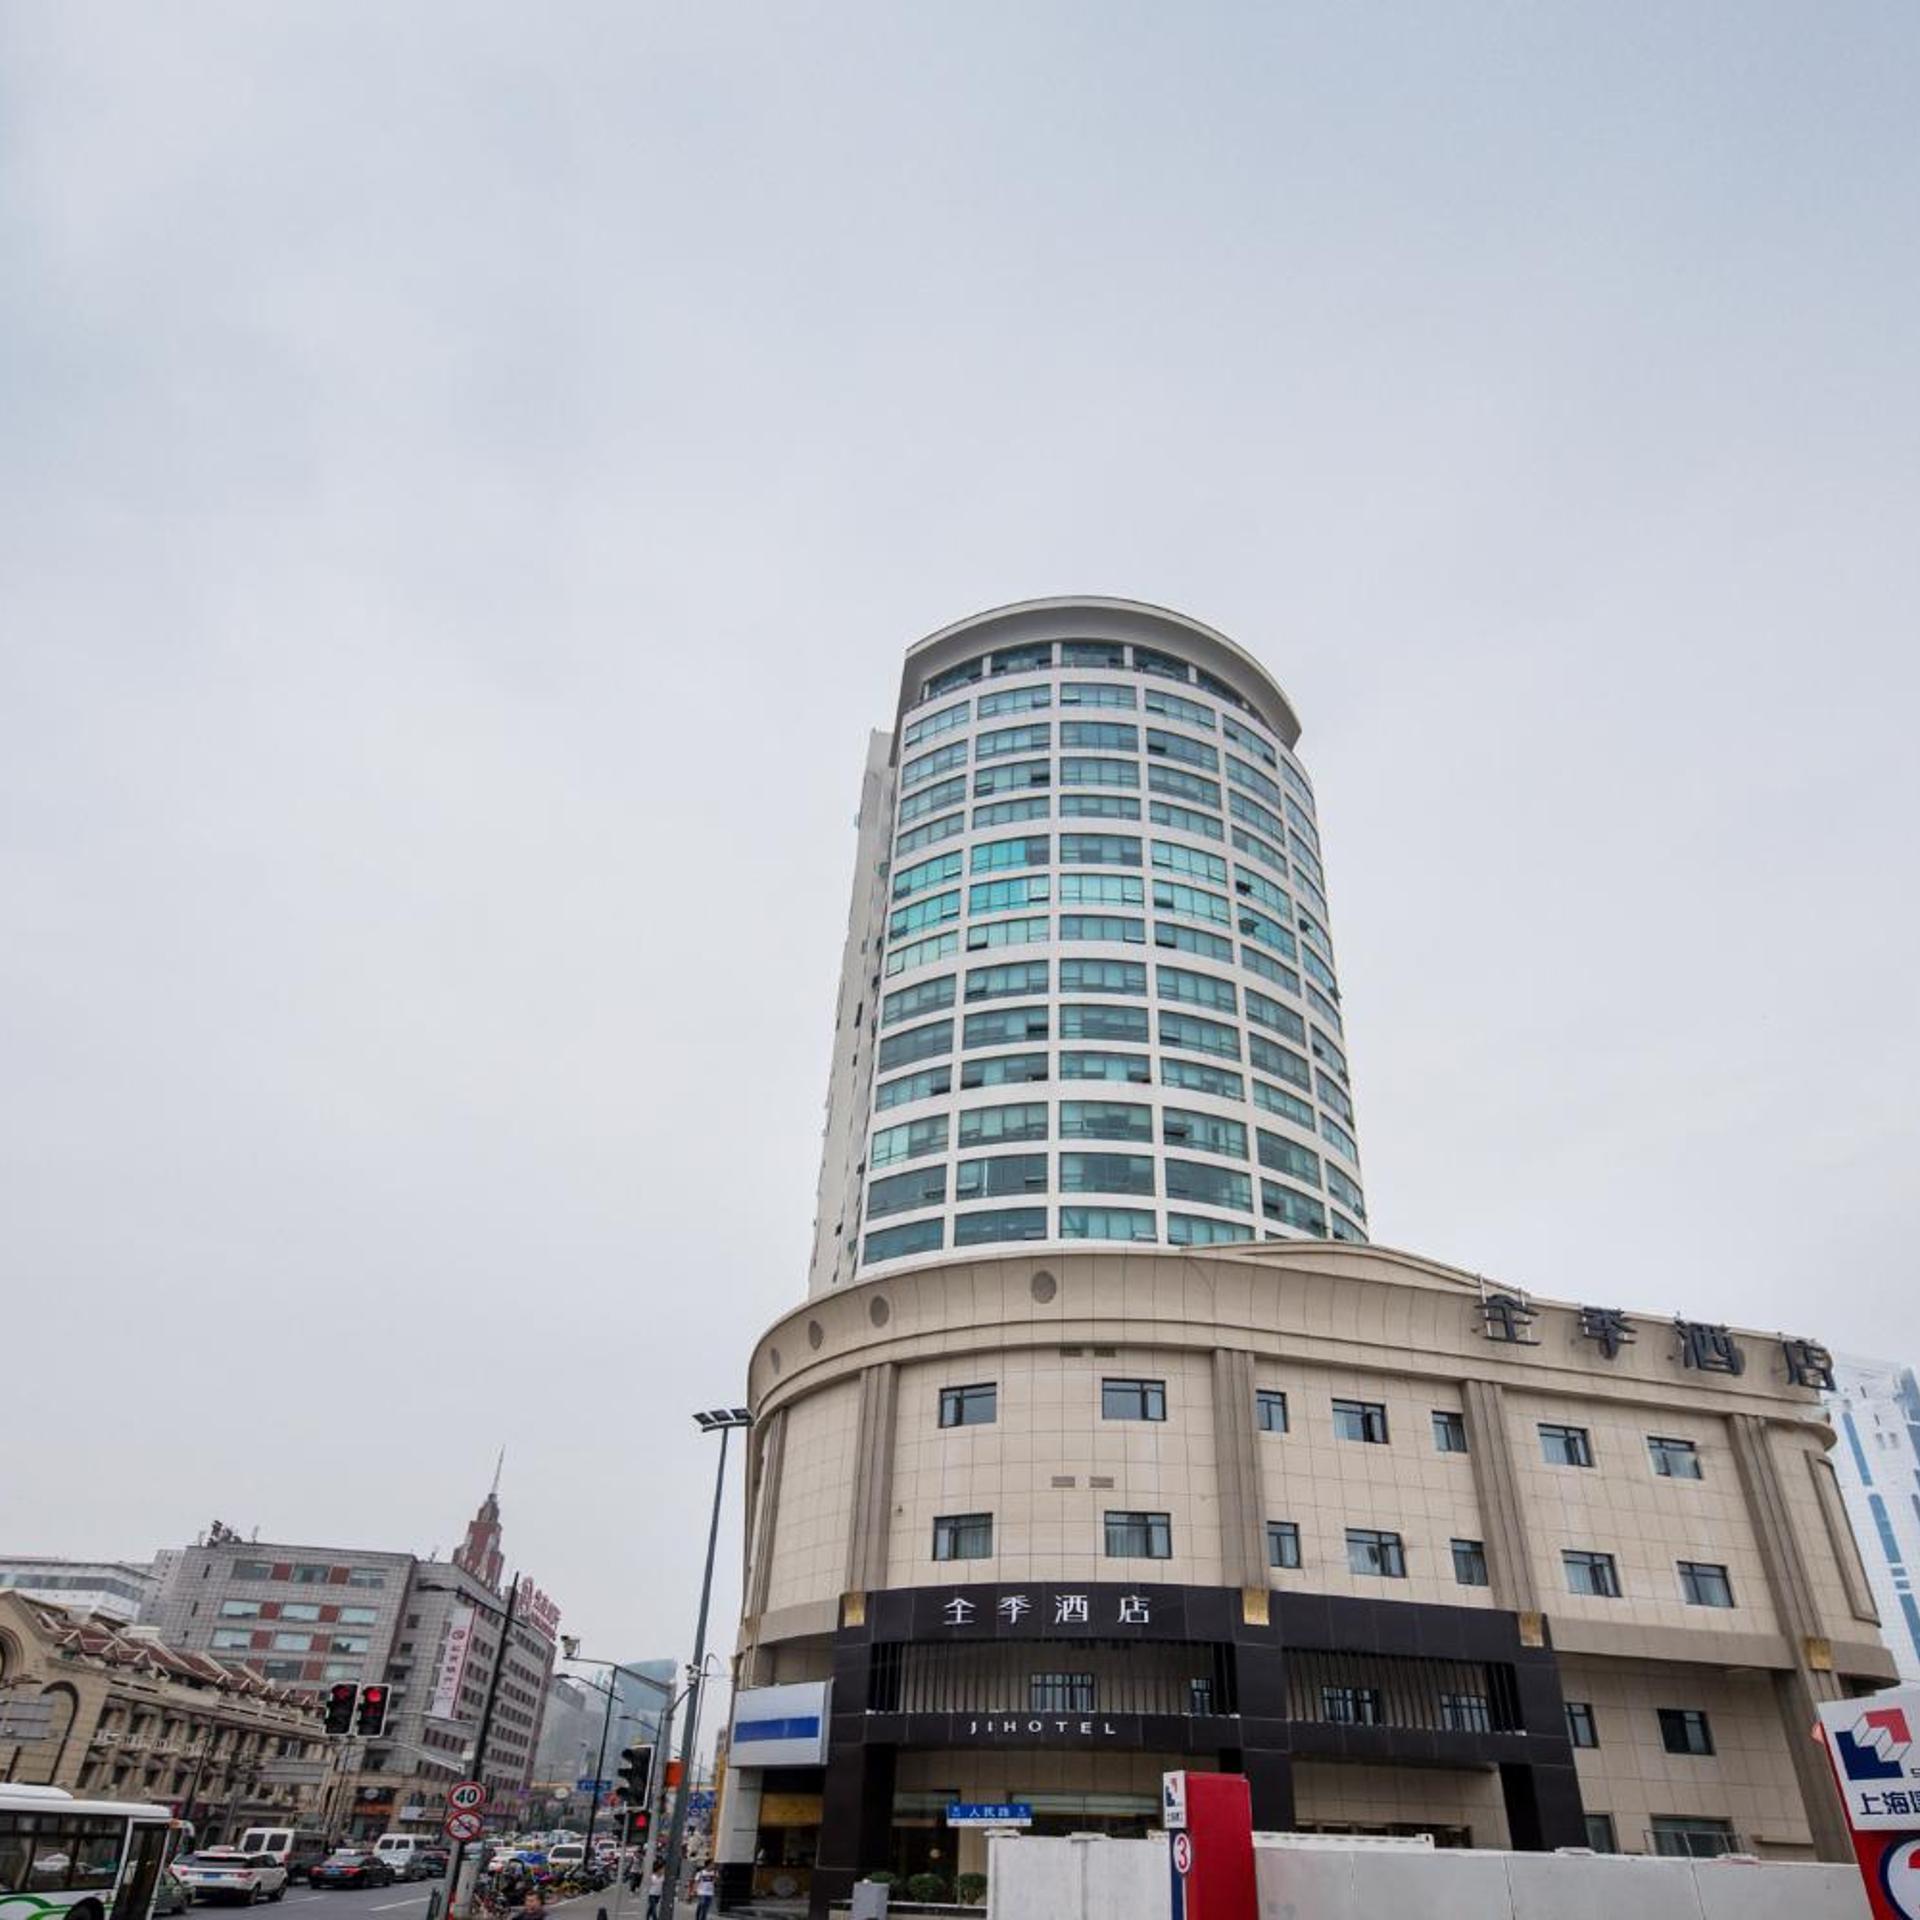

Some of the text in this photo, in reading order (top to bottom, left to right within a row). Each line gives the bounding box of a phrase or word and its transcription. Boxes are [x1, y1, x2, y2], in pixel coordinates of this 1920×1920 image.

[1474, 1293, 1837, 1391] 全季酒店
[943, 1594, 1151, 1625] 全季酒店
[456, 1788, 477, 1804] 40
[1177, 1836, 1188, 1871] 3
